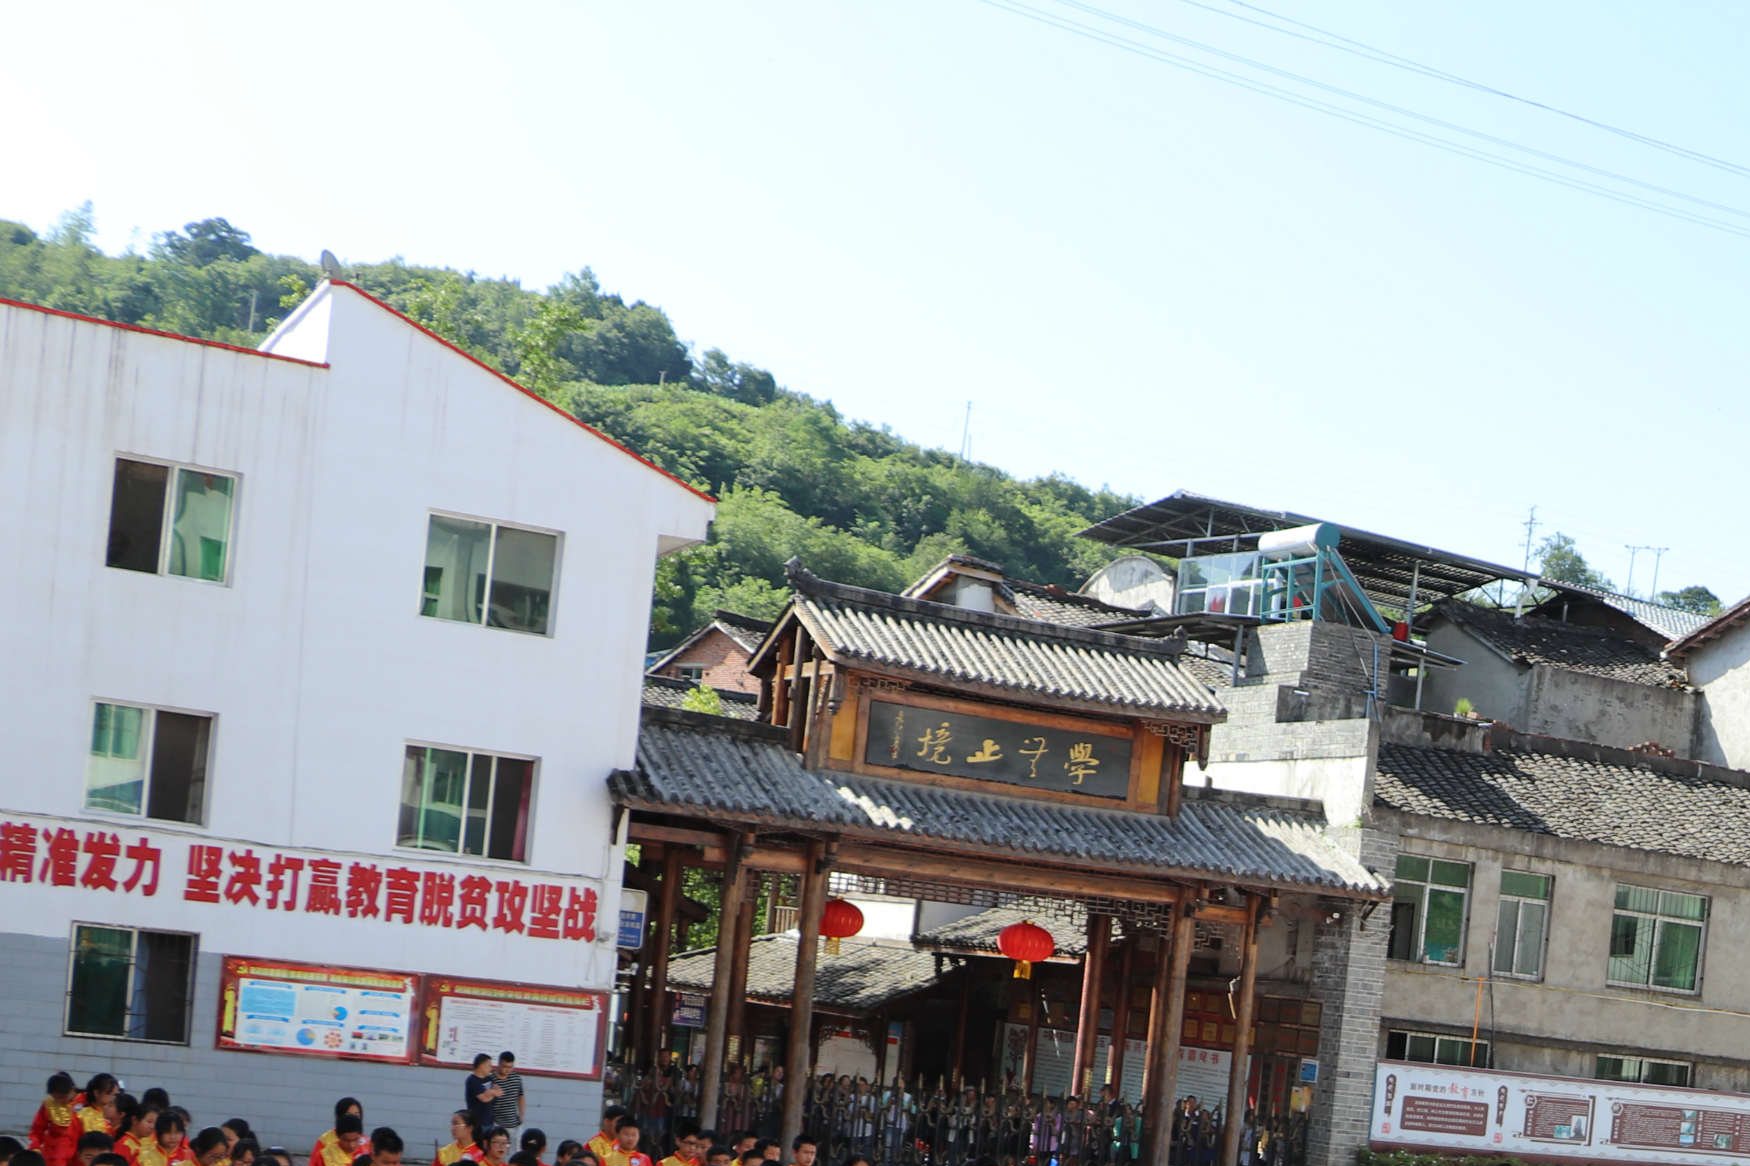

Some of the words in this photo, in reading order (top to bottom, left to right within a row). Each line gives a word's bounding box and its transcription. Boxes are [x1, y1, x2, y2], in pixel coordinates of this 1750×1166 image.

[0, 821, 162, 898] 精准发力
[184, 844, 599, 944] 坚决打赢教育脱贫攻坚战
